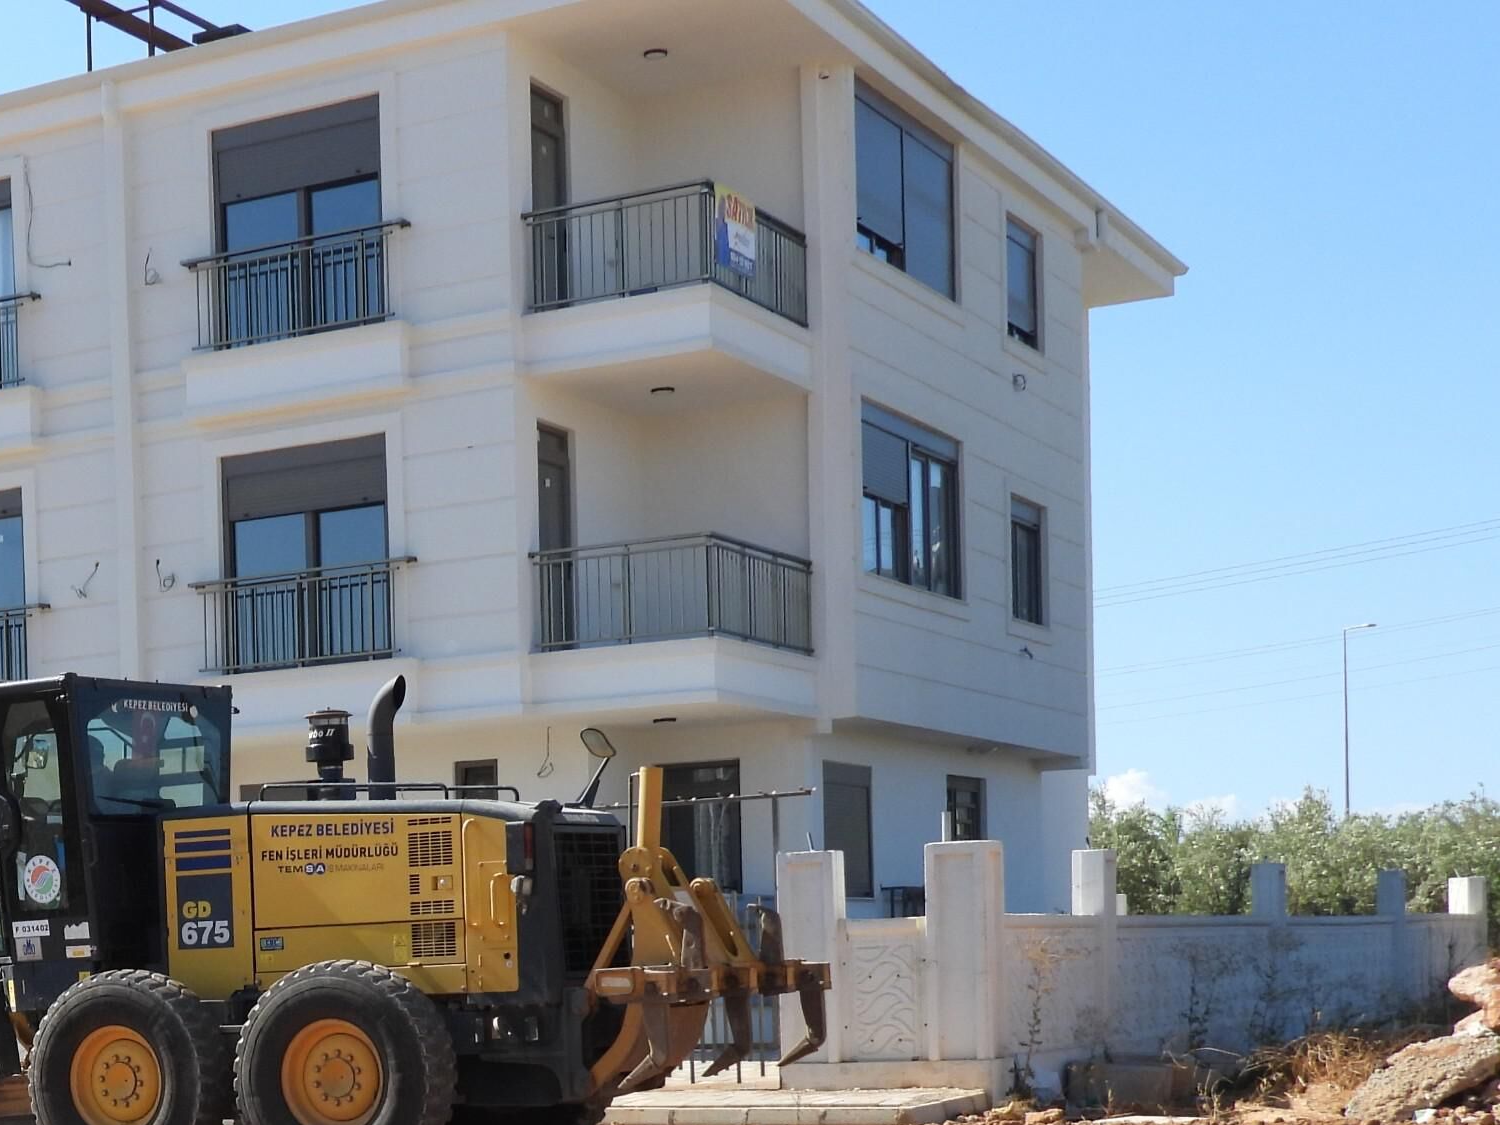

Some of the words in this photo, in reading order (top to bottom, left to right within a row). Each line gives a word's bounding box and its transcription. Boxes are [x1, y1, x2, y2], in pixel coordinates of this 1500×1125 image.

[123, 699, 147, 710] KEPEZ
[148, 701, 189, 712] BELEDİYESİ
[271, 824, 313, 838] KEPEZ
[316, 818, 394, 837] BELEDİYESİ
[261, 850, 283, 862] FEN
[286, 845, 323, 861] İŞLERİ
[325, 842, 398, 860] MÜDÜRLÜĞÜ
[278, 863, 326, 875] TEMSA
[182, 900, 212, 919] GD
[21, 923, 49, 934] 031402
[181, 920, 230, 945] 675
